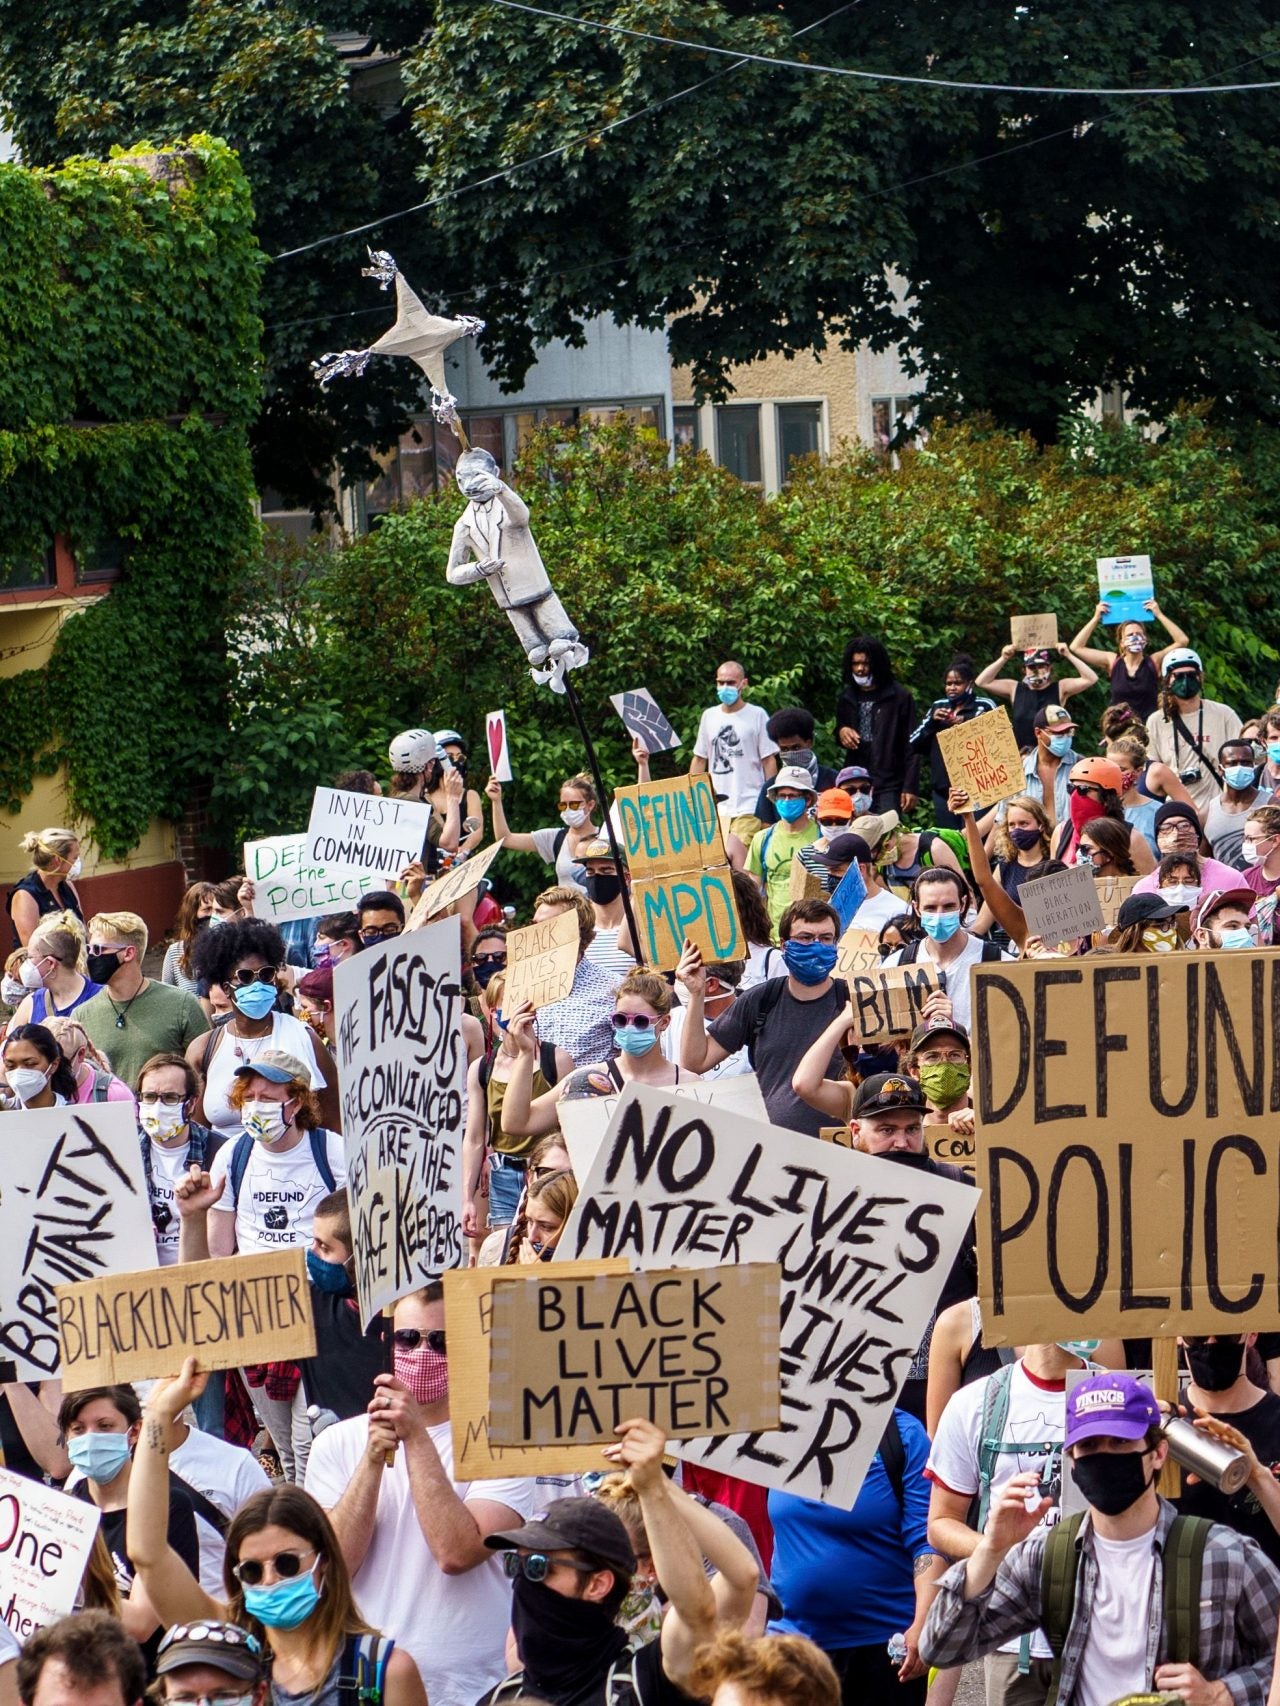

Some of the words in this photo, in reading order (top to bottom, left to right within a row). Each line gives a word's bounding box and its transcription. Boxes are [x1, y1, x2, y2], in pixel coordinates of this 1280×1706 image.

[966, 735, 988, 761] SAY
[962, 757, 993, 782] THEIR
[975, 765, 1009, 793] NAMES
[328, 793, 404, 826] INVEST
[620, 781, 717, 859] DEFUND
[348, 823, 366, 841] IN
[312, 836, 418, 873] COMMUNITY
[293, 866, 327, 883] the
[1022, 886, 1048, 899] QUEER
[1049, 874, 1073, 892] PEOPLE
[267, 876, 372, 916] POLICE
[1036, 901, 1092, 929] LIBERATION
[1044, 895, 1072, 910] BLACK
[645, 874, 738, 966] MPD
[1062, 925, 1080, 937] PRIDE
[514, 921, 559, 962] BLACK
[512, 950, 558, 988] LIVES
[507, 971, 569, 1016] MATTER
[854, 968, 933, 1038] BLM
[339, 1000, 361, 1069] THE
[368, 952, 461, 1085] FASCISTS
[358, 1064, 462, 1133] CONVINCED
[377, 1123, 413, 1170] ARE
[419, 1130, 456, 1192] THE
[253, 1191, 305, 1203] #DEFUND
[605, 1098, 715, 1194] NO
[731, 1142, 945, 1274] LIVES
[257, 1231, 297, 1243] POLICE
[395, 1151, 463, 1290] KEEPERS
[576, 1196, 755, 1264] MATTER
[778, 1221, 907, 1324] UNTIL
[538, 1279, 727, 1332] BLACK
[559, 1331, 722, 1379] LIVES
[523, 1376, 730, 1440] MATTER
[1075, 1390, 1125, 1409] VIKINGS
